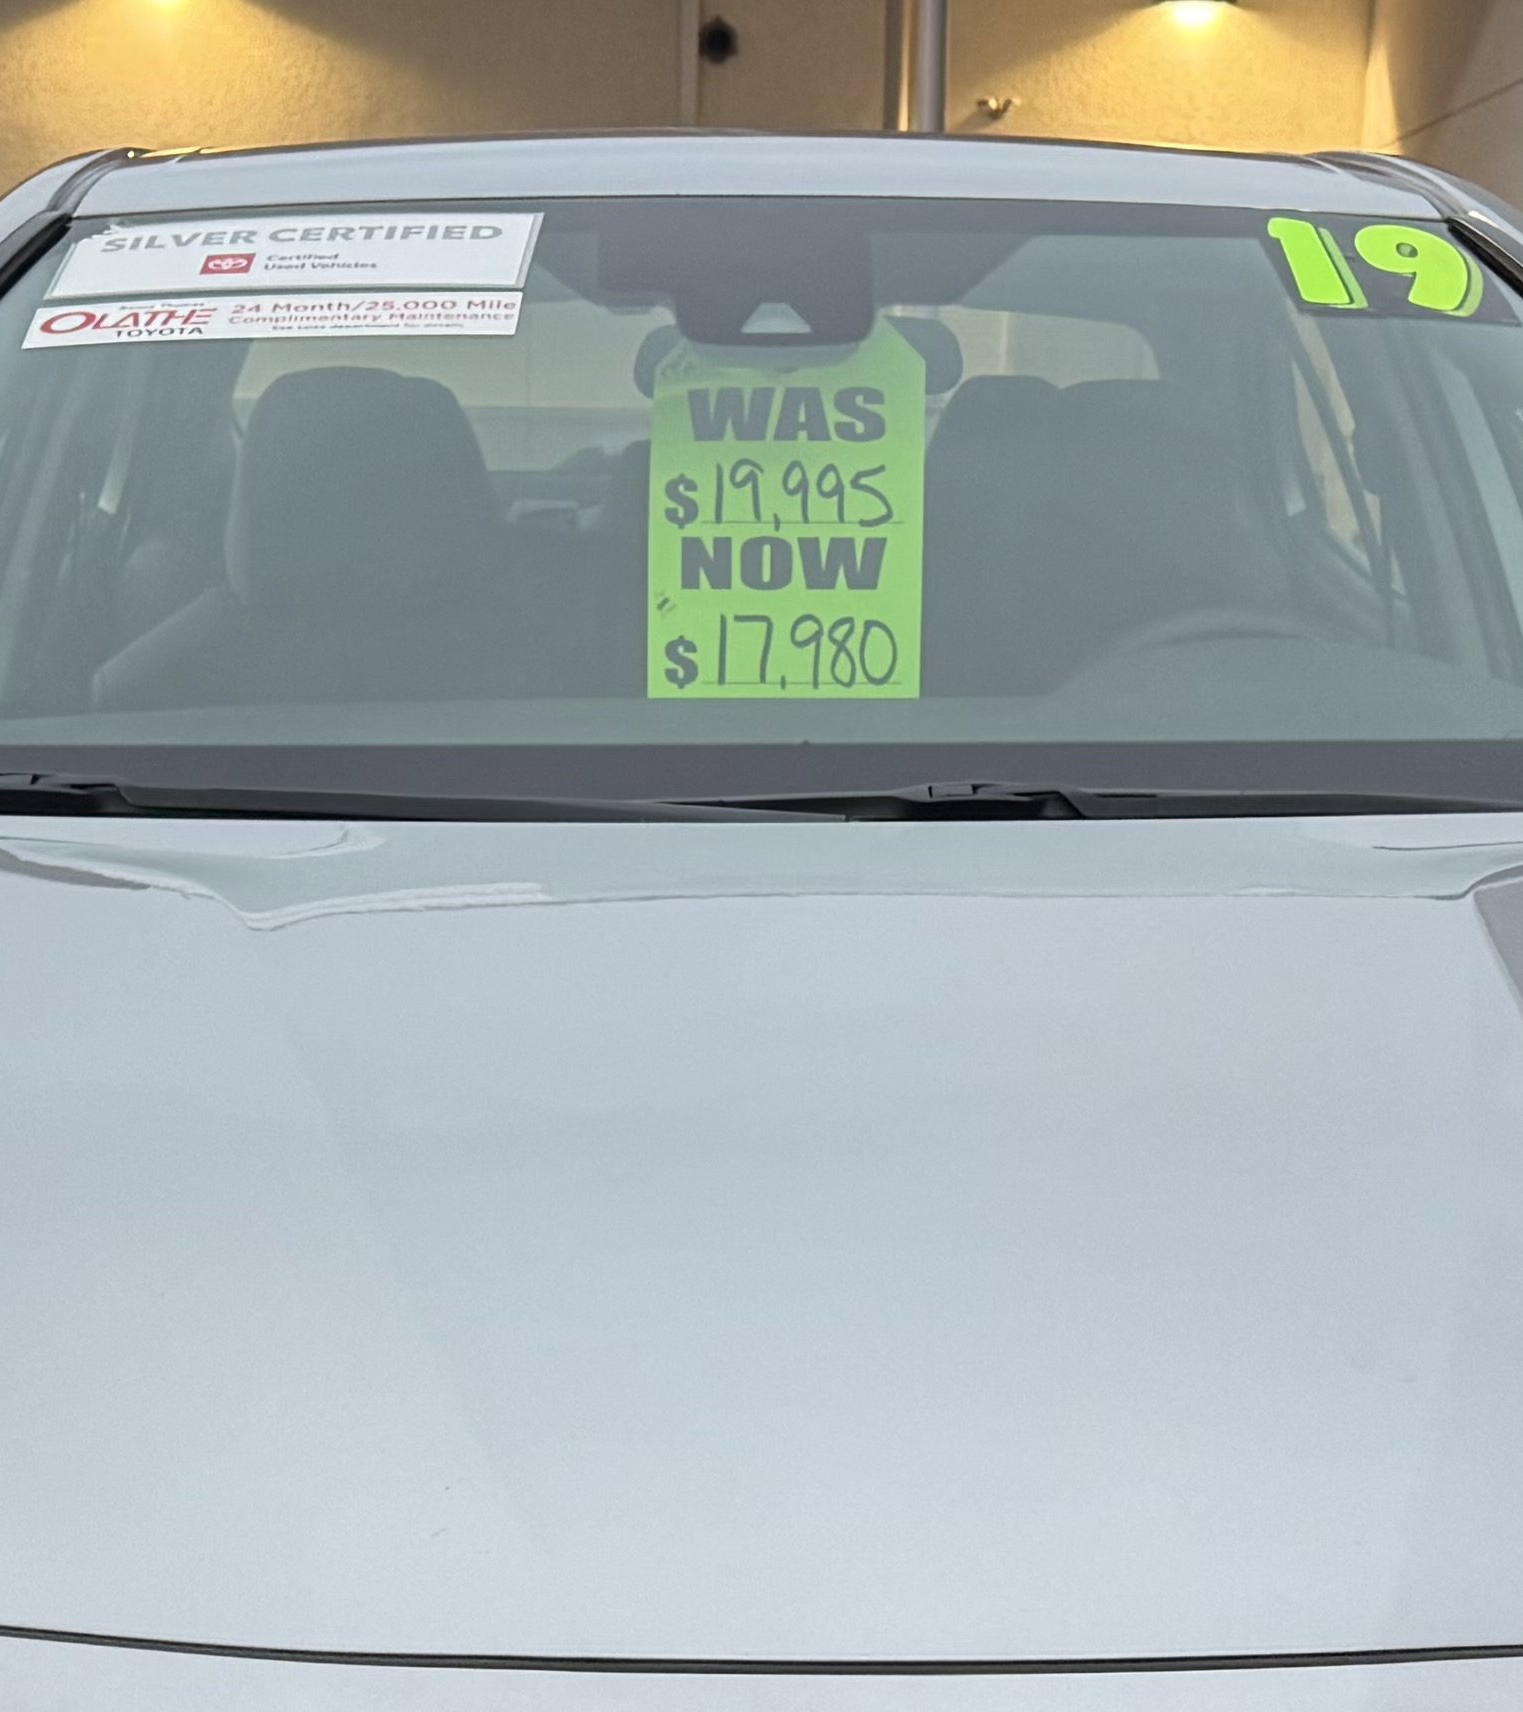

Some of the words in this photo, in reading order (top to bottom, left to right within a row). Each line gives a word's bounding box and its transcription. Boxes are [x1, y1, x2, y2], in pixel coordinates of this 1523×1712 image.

[100, 230, 257, 252] SILVER
[269, 225, 503, 243] CERTIFIED
[264, 262, 306, 271] Used
[310, 261, 377, 270] Vehicles
[266, 253, 340, 262] Certified
[1268, 217, 1484, 317] 19
[228, 312, 380, 325] Complimentary
[389, 311, 515, 321] Maintenance
[231, 304, 262, 315] 24
[467, 300, 517, 310] Mile
[40, 308, 218, 334] OLATHE
[117, 327, 203, 338] TOYOTA
[687, 386, 886, 442] WAS
[664, 459, 894, 531] $19,995
[681, 536, 888, 590] NOW
[664, 614, 898, 690] $17,980
